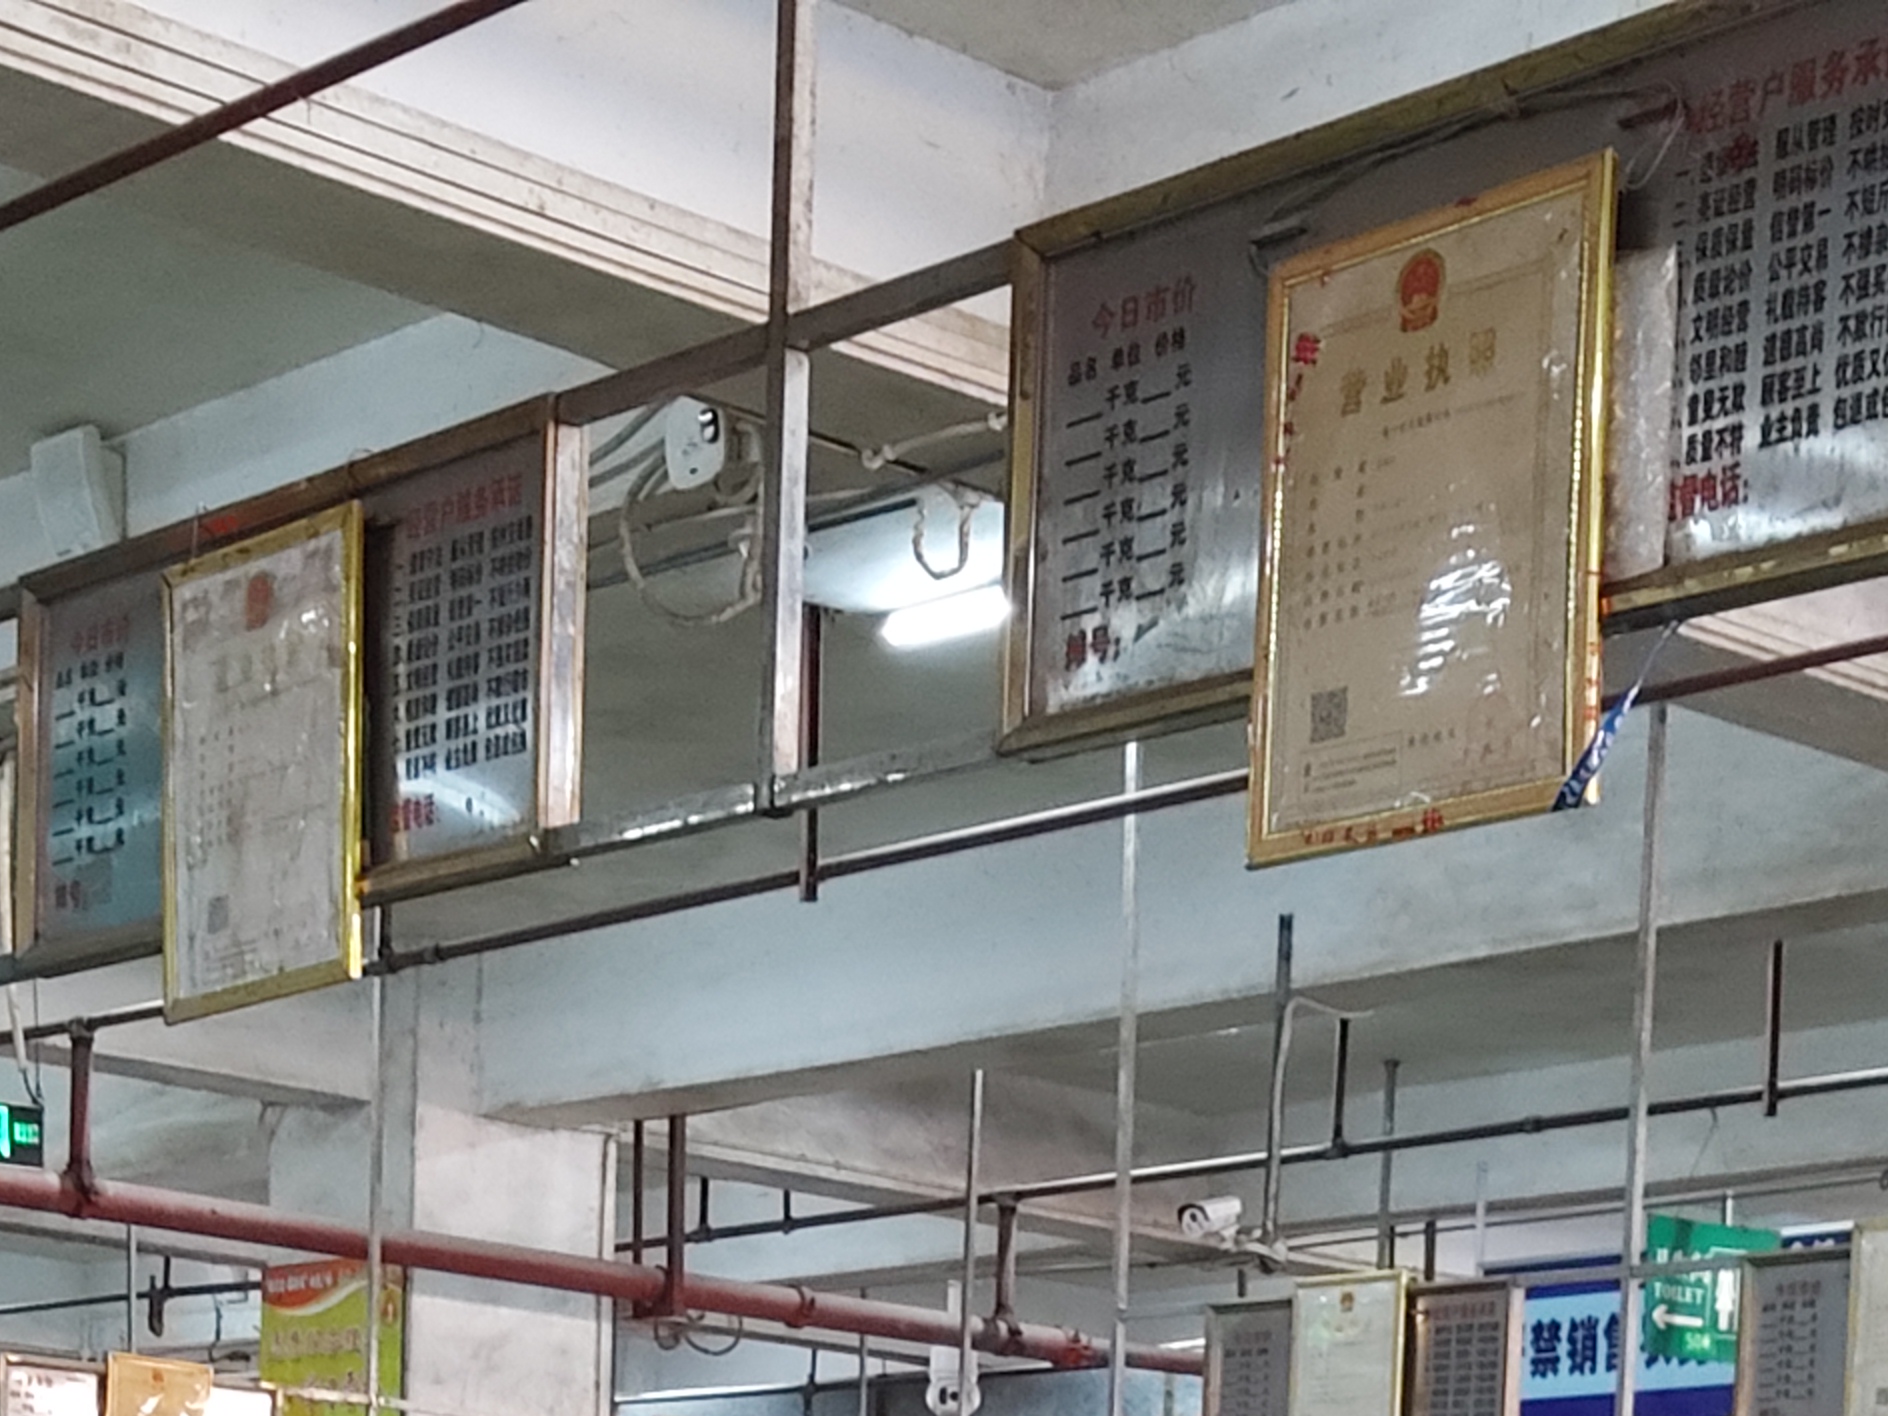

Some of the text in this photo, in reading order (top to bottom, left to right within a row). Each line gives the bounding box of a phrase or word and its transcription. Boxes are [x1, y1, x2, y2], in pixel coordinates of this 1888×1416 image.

[1768, 236, 1829, 282] 公平交易
[1690, 299, 1751, 345] 文明经营
[1653, 1281, 1705, 1305] TOILET
